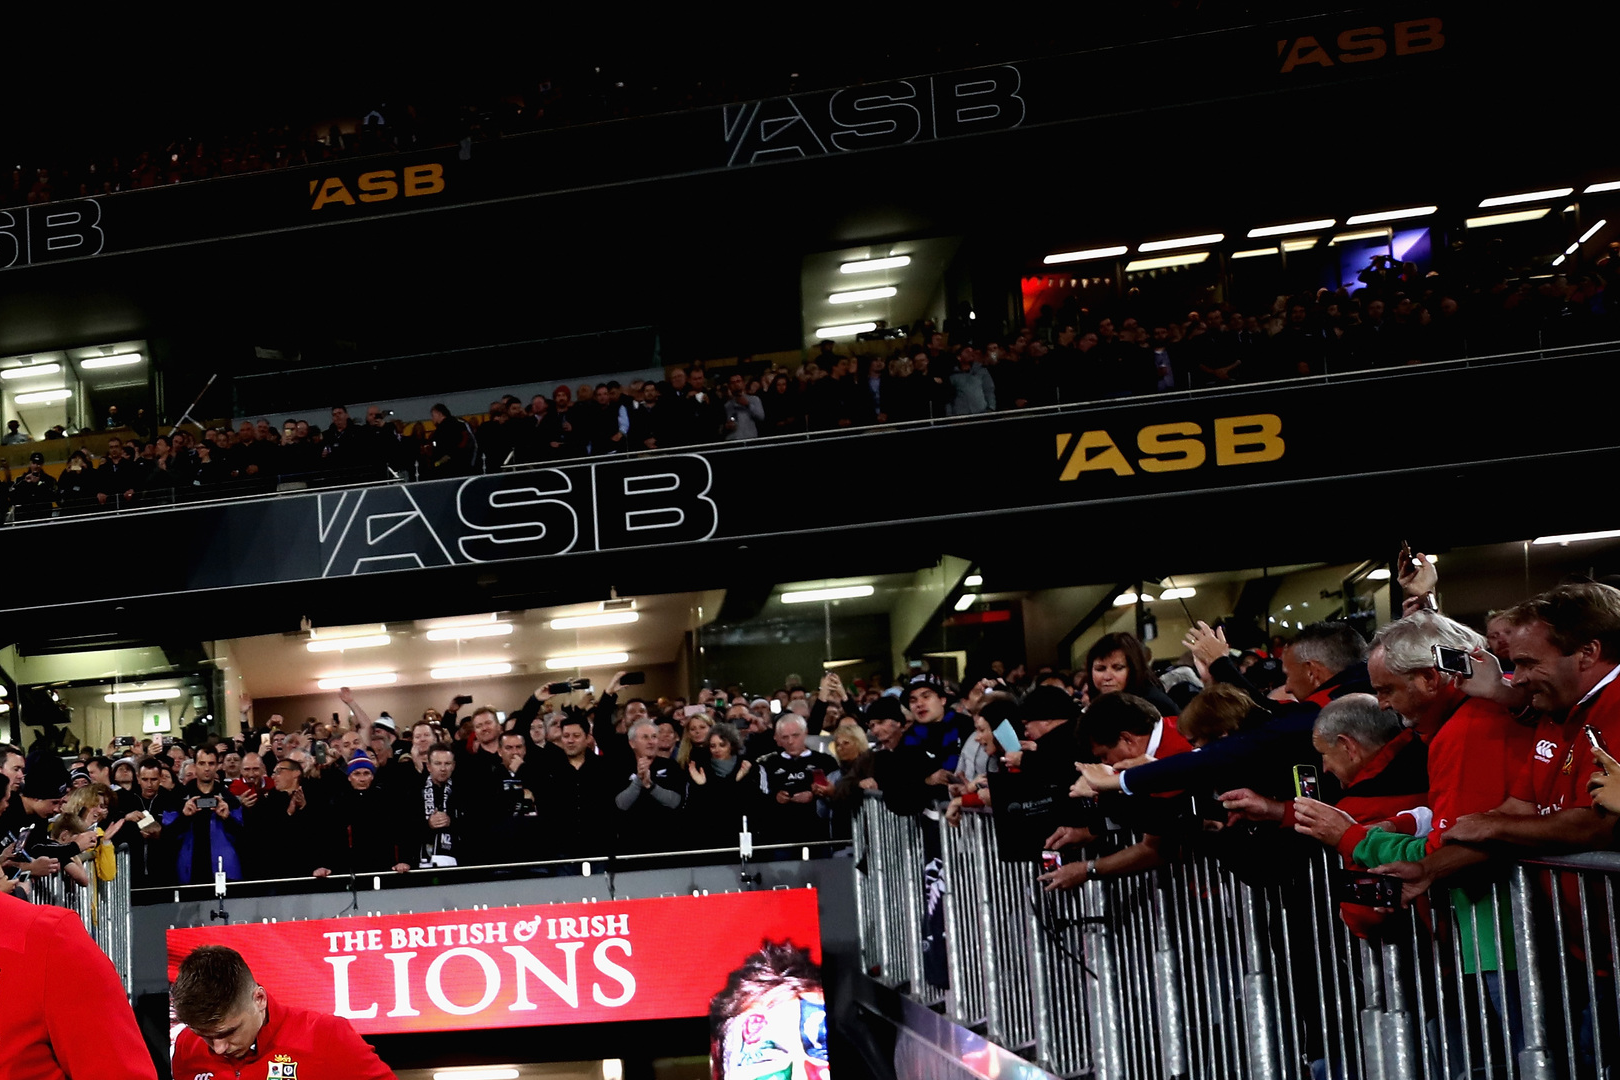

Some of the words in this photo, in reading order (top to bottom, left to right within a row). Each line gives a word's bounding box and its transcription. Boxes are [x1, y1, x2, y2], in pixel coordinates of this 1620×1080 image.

[1277, 17, 1446, 74] ASB
[723, 64, 1026, 167] ASB
[309, 163, 446, 211] ASB
[1055, 412, 1287, 483] ASB
[316, 453, 719, 580] ASB
[788, 771, 805, 781] AIG
[323, 929, 382, 952] THE
[390, 922, 508, 949] BRITISH
[513, 915, 541, 941] &
[547, 914, 630, 939] IRISH
[323, 938, 637, 1020] LIONS
